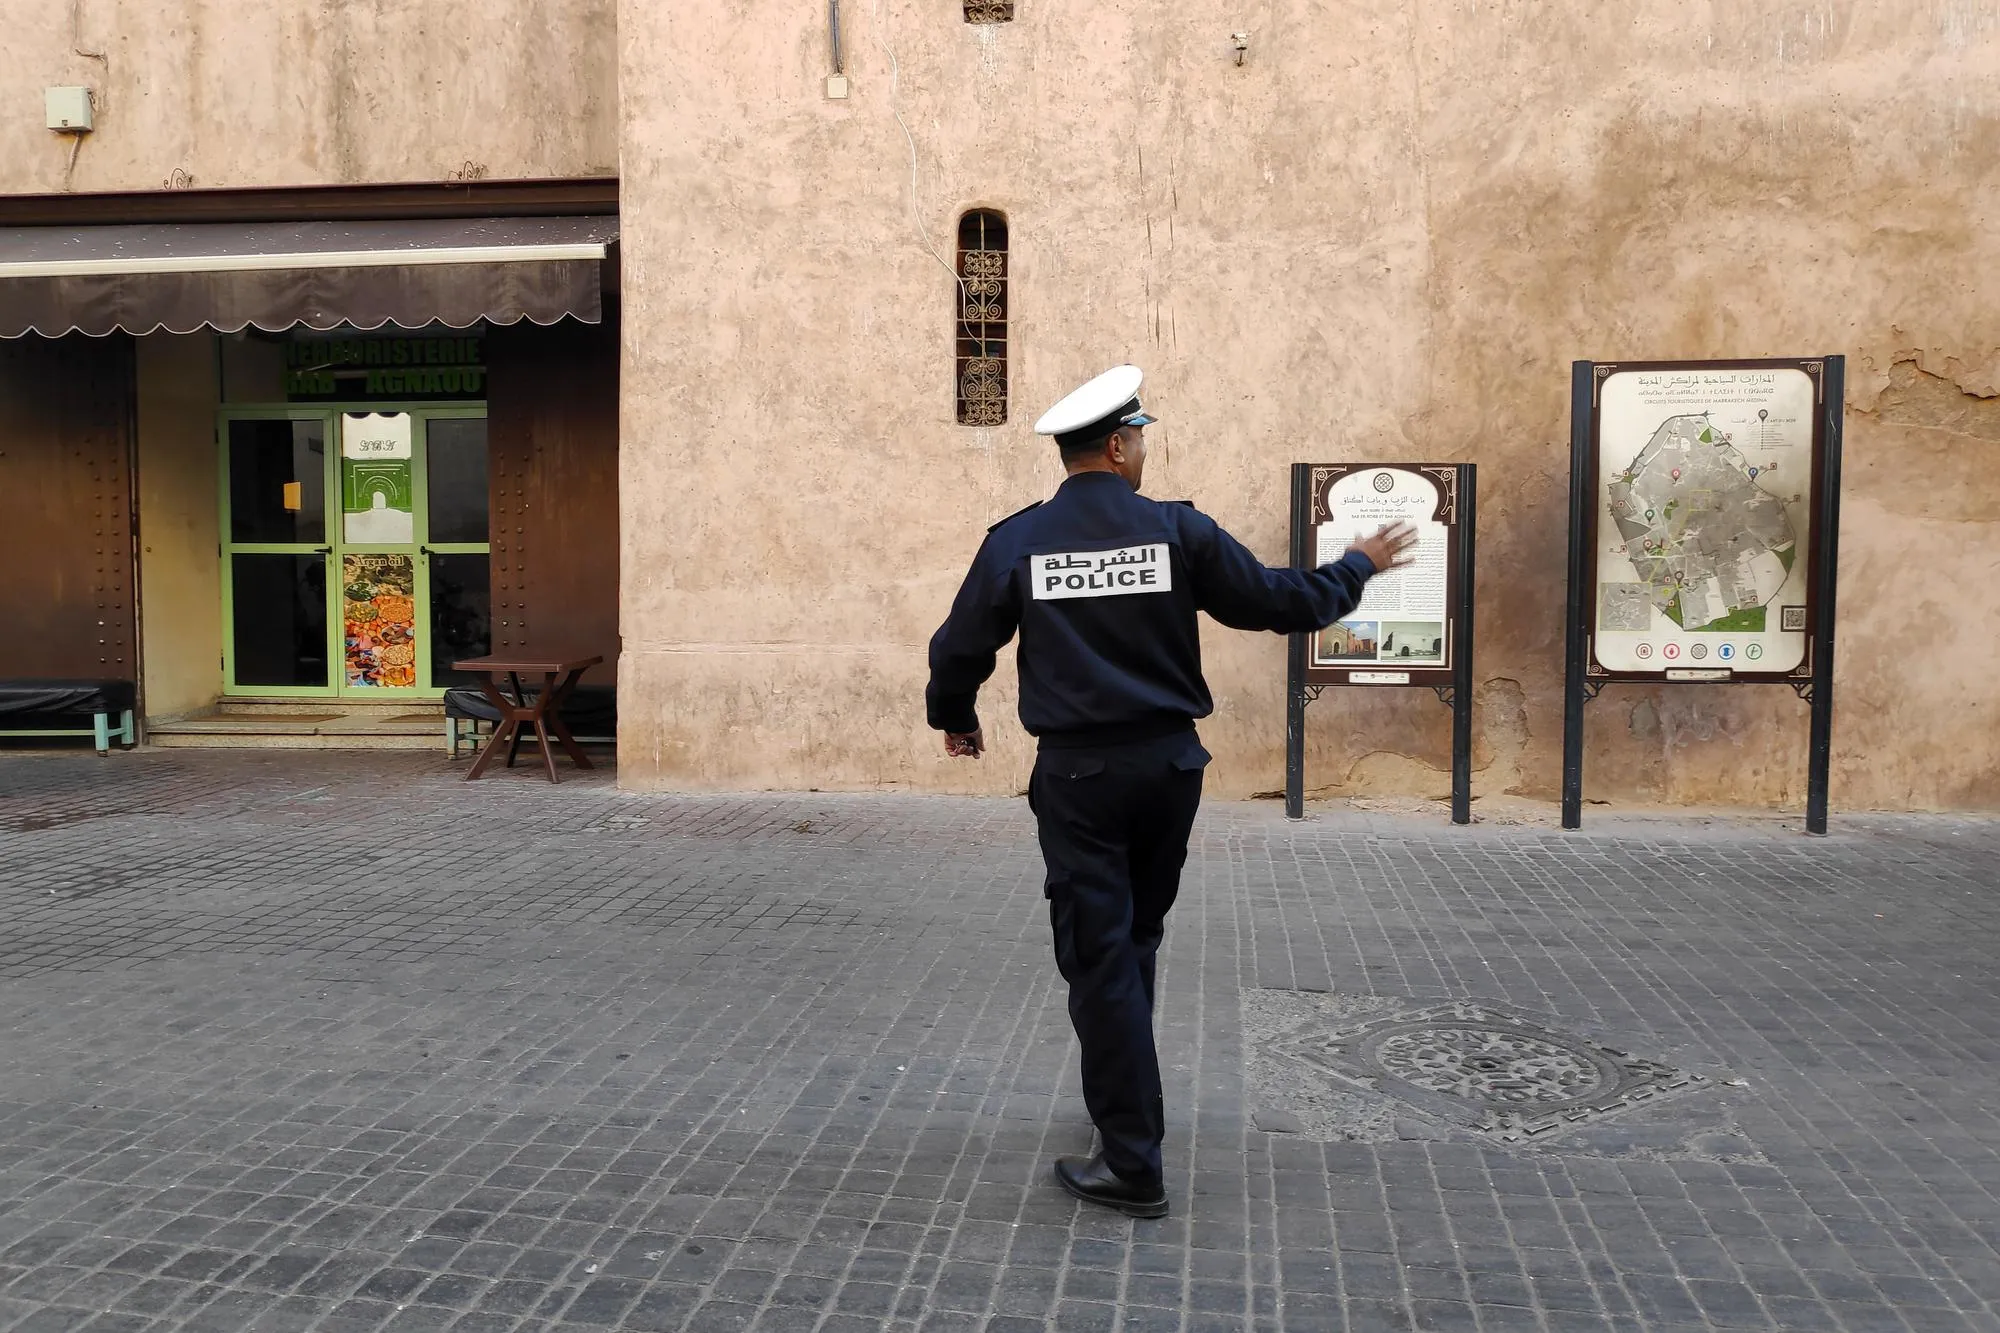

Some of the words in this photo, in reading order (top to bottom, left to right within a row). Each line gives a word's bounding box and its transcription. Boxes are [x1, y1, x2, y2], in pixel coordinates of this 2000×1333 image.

[366, 367, 482, 394] AGNAOU
[356, 557, 387, 569] Argan
[388, 555, 404, 566] oil
[1045, 548, 1156, 573] الشرطة
[1045, 569, 1157, 592] POLICE
